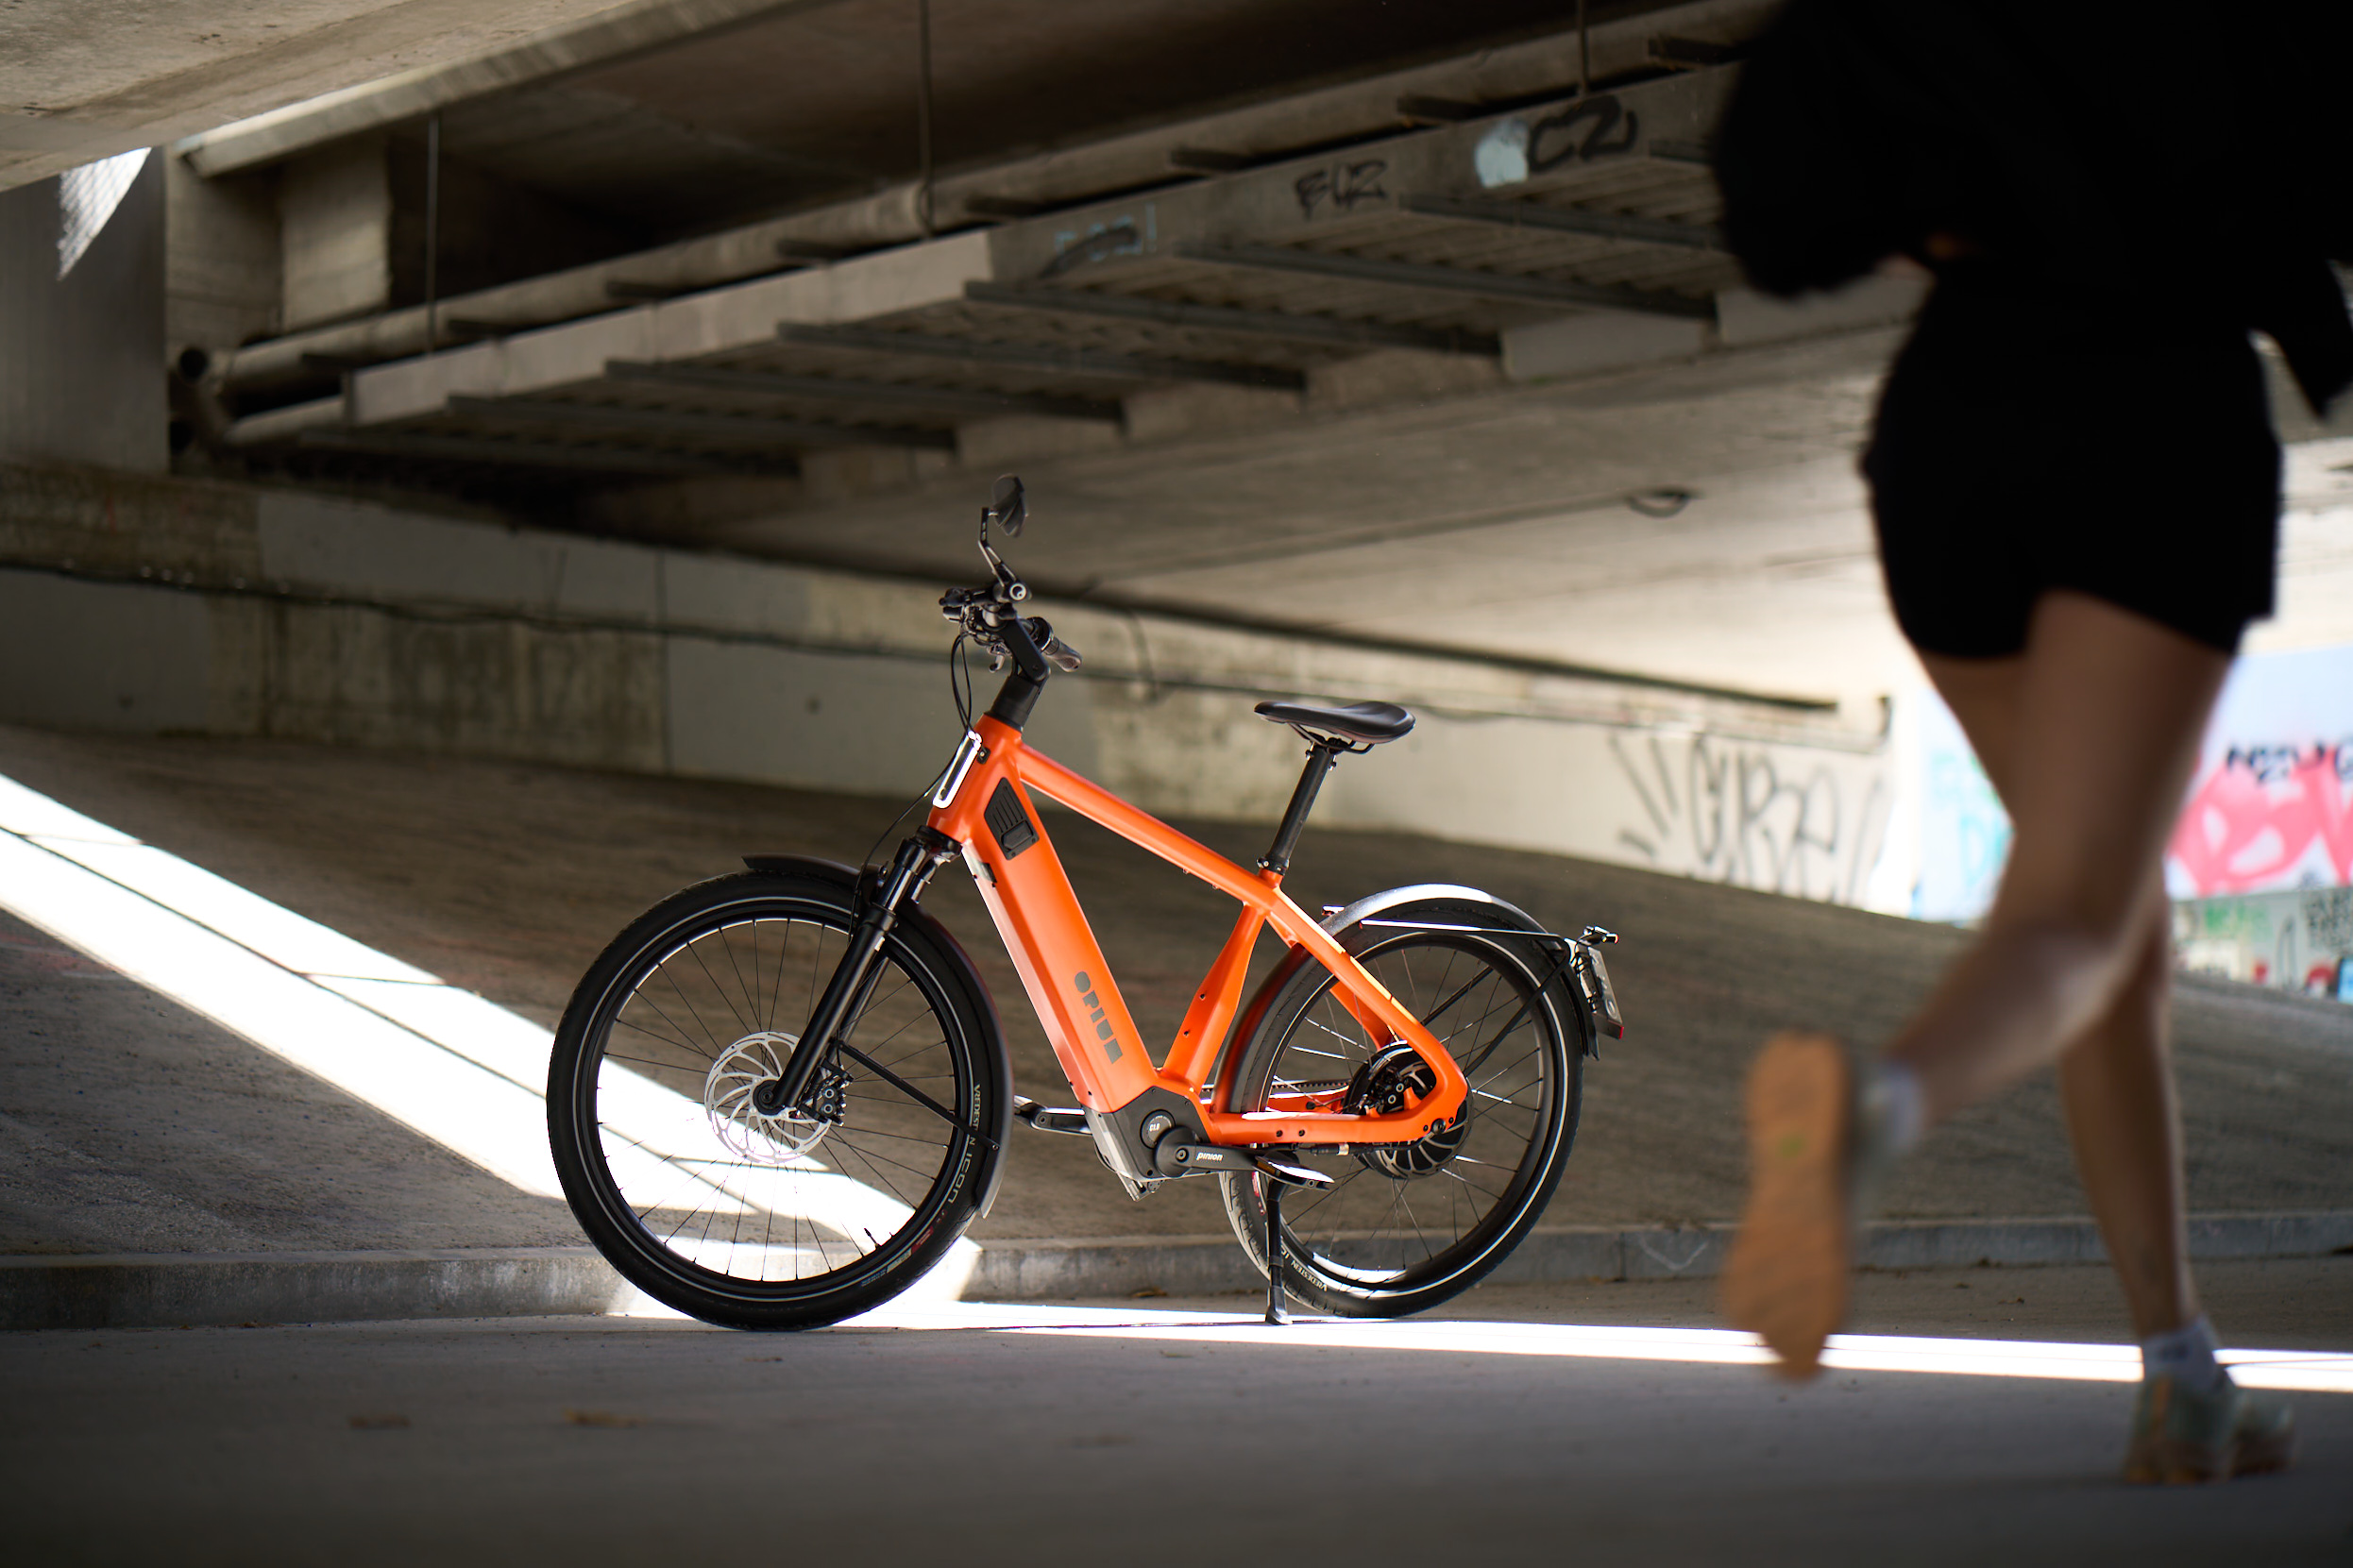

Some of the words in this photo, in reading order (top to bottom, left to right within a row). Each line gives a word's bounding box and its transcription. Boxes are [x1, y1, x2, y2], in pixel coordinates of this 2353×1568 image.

[1074, 970, 1124, 1064] OPIUM
[969, 1084, 981, 1146] VREDESTN
[947, 1153, 973, 1204] ICON
[1195, 1152, 1224, 1161] pinion
